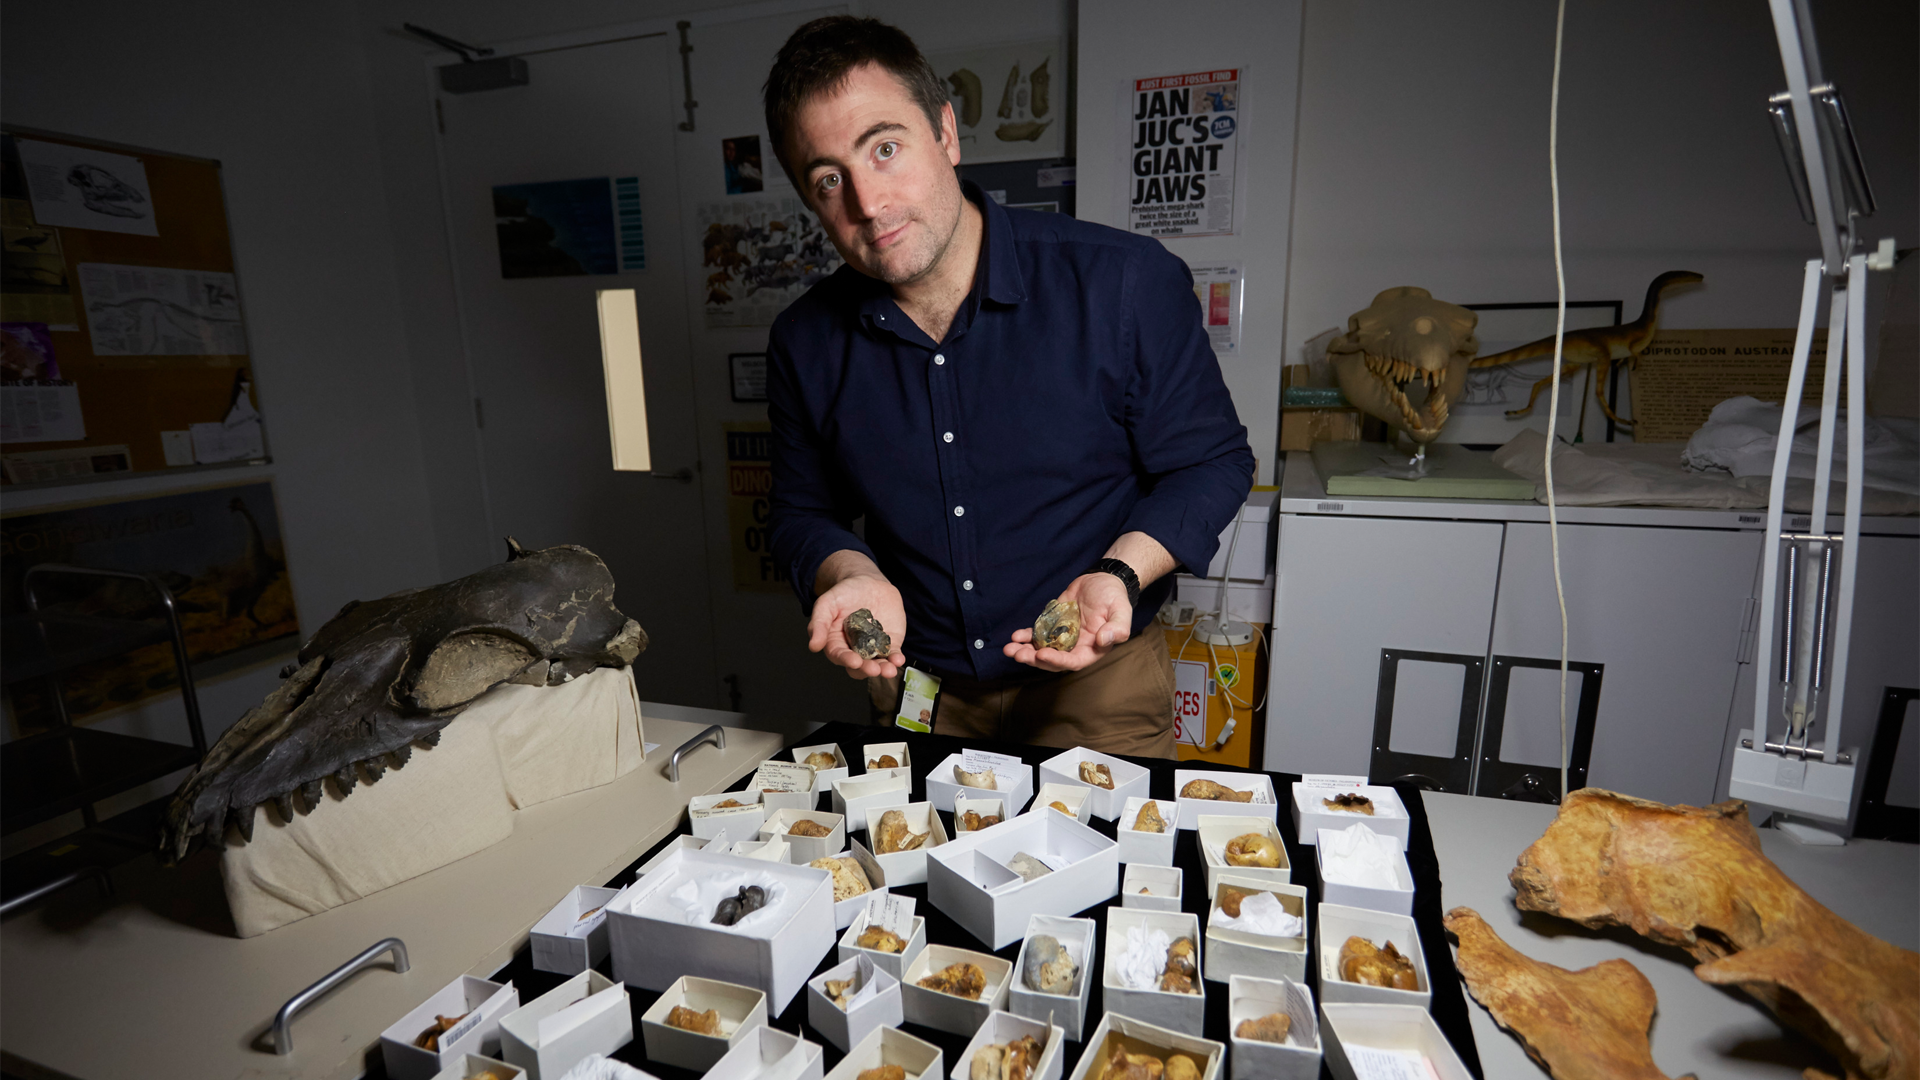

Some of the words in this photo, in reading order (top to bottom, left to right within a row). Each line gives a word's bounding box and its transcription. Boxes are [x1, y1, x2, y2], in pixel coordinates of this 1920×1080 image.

[1140, 79, 1159, 90] AUST
[1162, 76, 1183, 87] FIRST
[1185, 74, 1210, 84] FOSSIL
[1212, 71, 1232, 81] FIND
[1135, 88, 1190, 120] JAN
[1214, 119, 1231, 130] 7CM
[1134, 116, 1209, 149] JUC'S
[1133, 144, 1223, 177] GIANT
[1132, 174, 1206, 205] JAWS
[1131, 204, 1165, 213] Prehistoric
[1167, 202, 1205, 211] mega-shark
[1135, 220, 1152, 229] great
[1153, 218, 1171, 226] white
[1172, 217, 1199, 226] snacked
[1139, 212, 1156, 220] twice
[1161, 226, 1183, 234] whales
